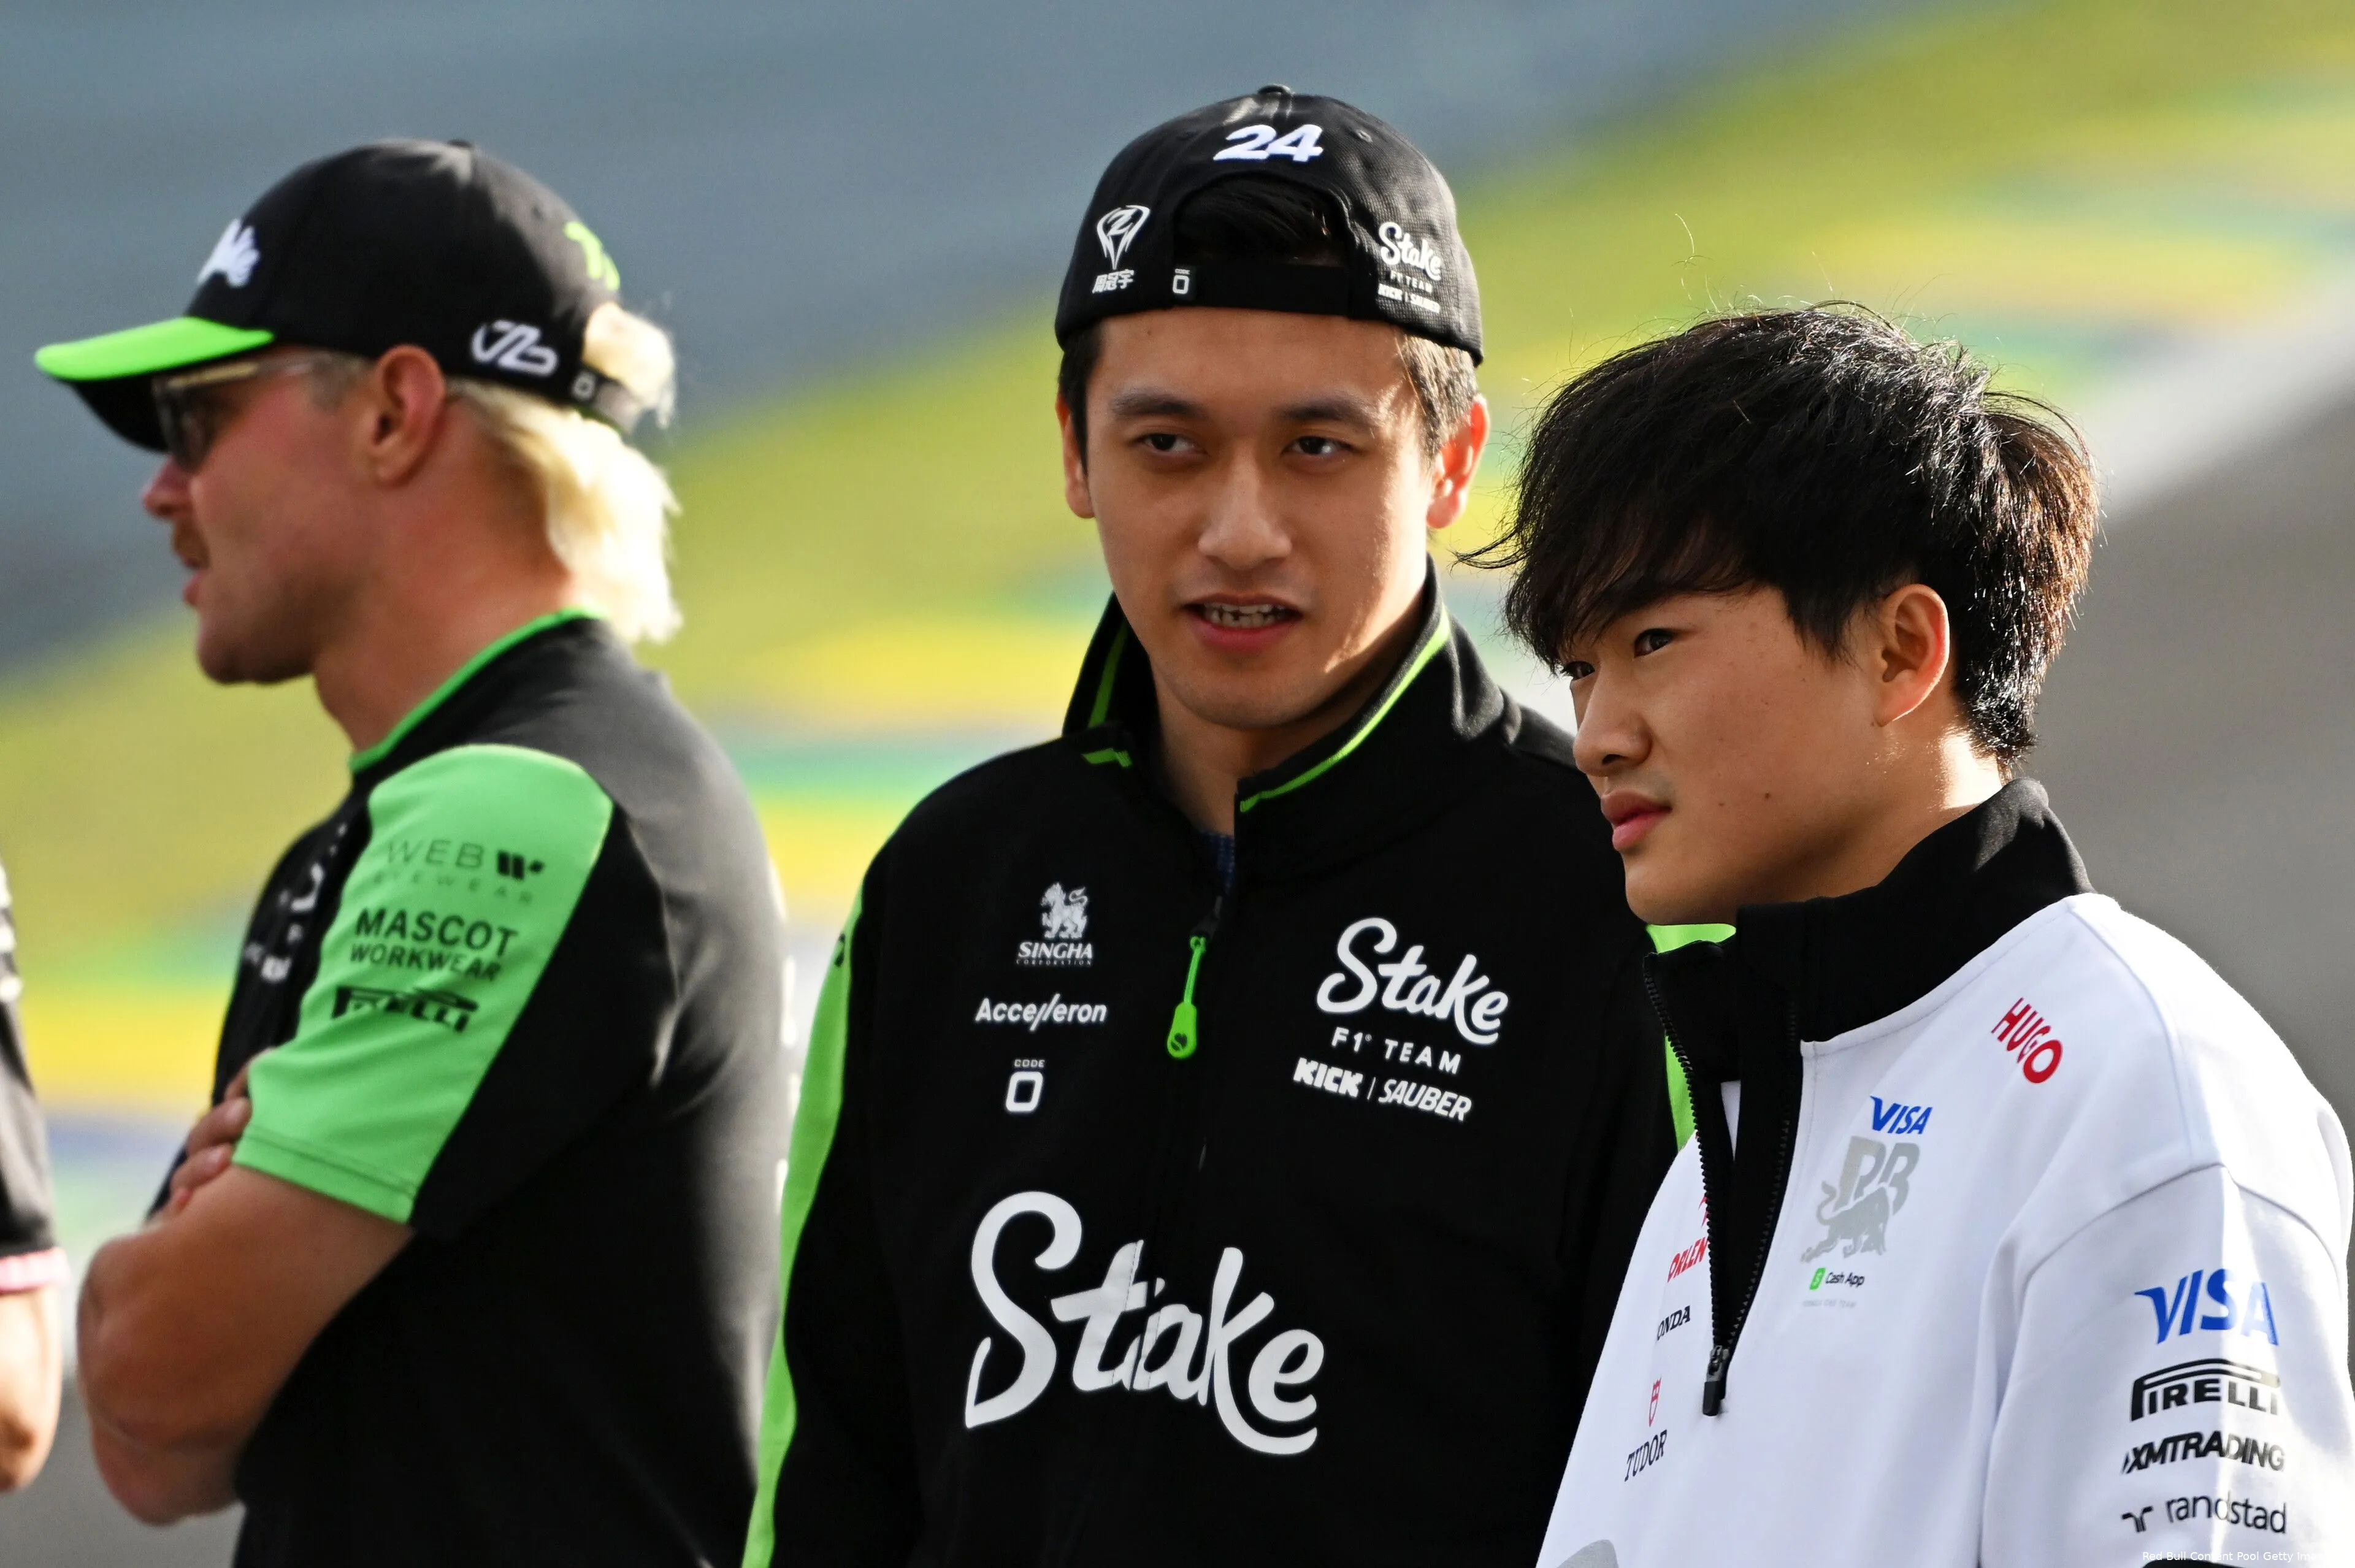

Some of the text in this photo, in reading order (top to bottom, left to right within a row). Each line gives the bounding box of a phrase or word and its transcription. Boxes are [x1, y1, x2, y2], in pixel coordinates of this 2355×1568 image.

[1213, 124, 1324, 163] 24
[1379, 221, 1442, 281] Stake
[1405, 275, 1433, 295] TEAM
[383, 838, 484, 870] WEB
[354, 908, 520, 957] MASCOT
[1017, 941, 1093, 960] SINGHA
[350, 943, 502, 982] WORKWEAR
[1315, 916, 1510, 1046] Stake
[974, 992, 1108, 1032] Accelleron
[1384, 1038, 1462, 1075] TEAM
[1991, 996, 2064, 1084] HUGO
[1014, 1058, 1046, 1068] CODE
[1293, 1057, 1473, 1122] KICK SAUBER
[1869, 1095, 1934, 1135] VISA
[1667, 1236, 1708, 1283] ORLEN
[964, 1191, 1325, 1455] Stake
[1656, 1304, 1691, 1341] ONDA
[2134, 1268, 2279, 1346] VISA
[2130, 1358, 2280, 1422] PIRELLI
[1624, 1429, 1668, 1482] TUDOR
[2125, 1430, 2284, 1474] XMTRADING
[2165, 1490, 2287, 1534] randstad
